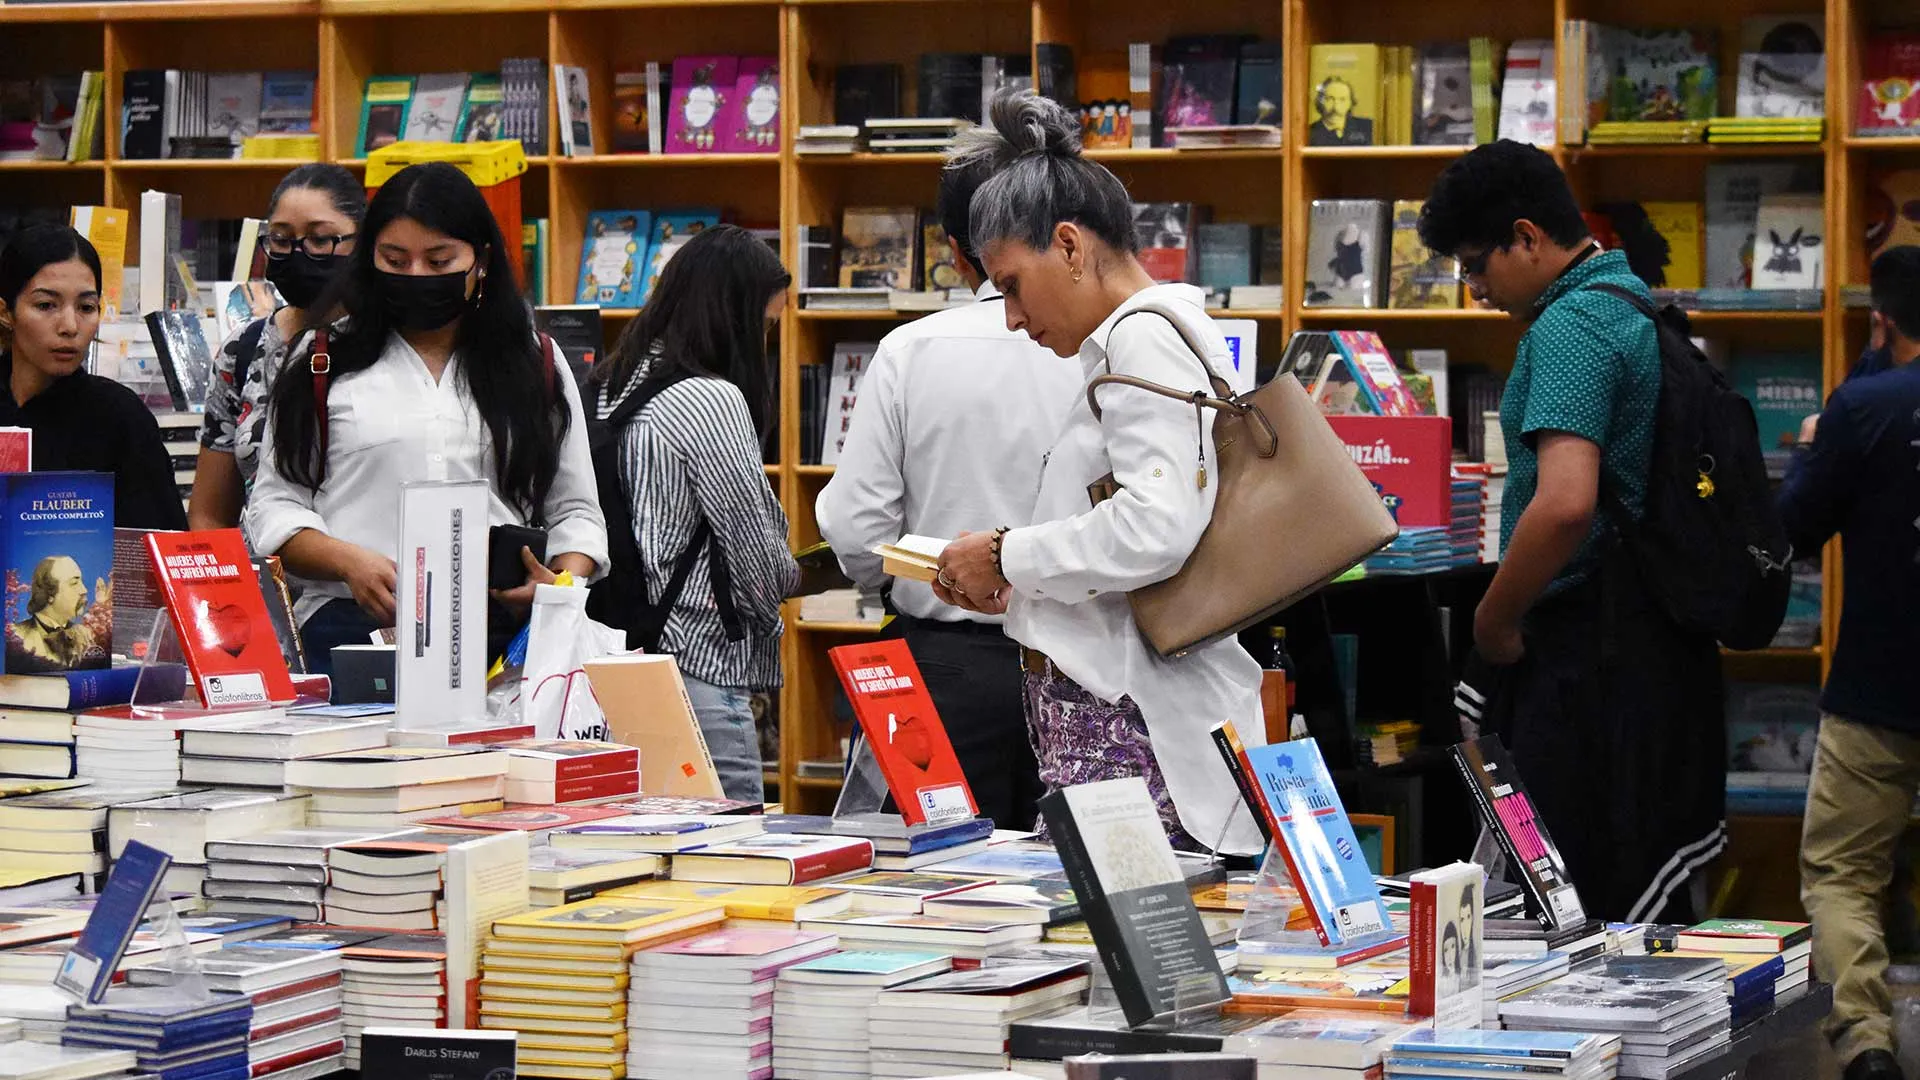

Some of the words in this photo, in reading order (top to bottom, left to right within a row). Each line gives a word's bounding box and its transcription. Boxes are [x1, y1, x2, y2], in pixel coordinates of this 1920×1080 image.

[32, 498, 93, 511] FLAUBERT
[20, 511, 57, 520] CUENTOS
[58, 509, 105, 519] COMPLETOS
[165, 556, 194, 567] MUJERES
[194, 554, 208, 567] QUE
[207, 554, 218, 564] YA
[170, 567, 181, 579] NO
[181, 566, 206, 578] SUFREN
[206, 566, 220, 577] POR
[219, 564, 240, 576] AMOR
[451, 507, 462, 689] RECOMENDACIONES
[852, 668, 877, 681] MUJERES
[875, 666, 889, 679] QUE
[885, 665, 895, 676] YA
[858, 682, 869, 693] NO
[866, 679, 889, 691] SUFREN
[885, 679, 899, 689] POR
[896, 676, 914, 688] AMOR
[213, 692, 264, 703] colofonlibros
[1265, 767, 1306, 793] Rusia
[404, 1046, 438, 1058] DARLIS
[440, 1048, 481, 1060] STEFANY
